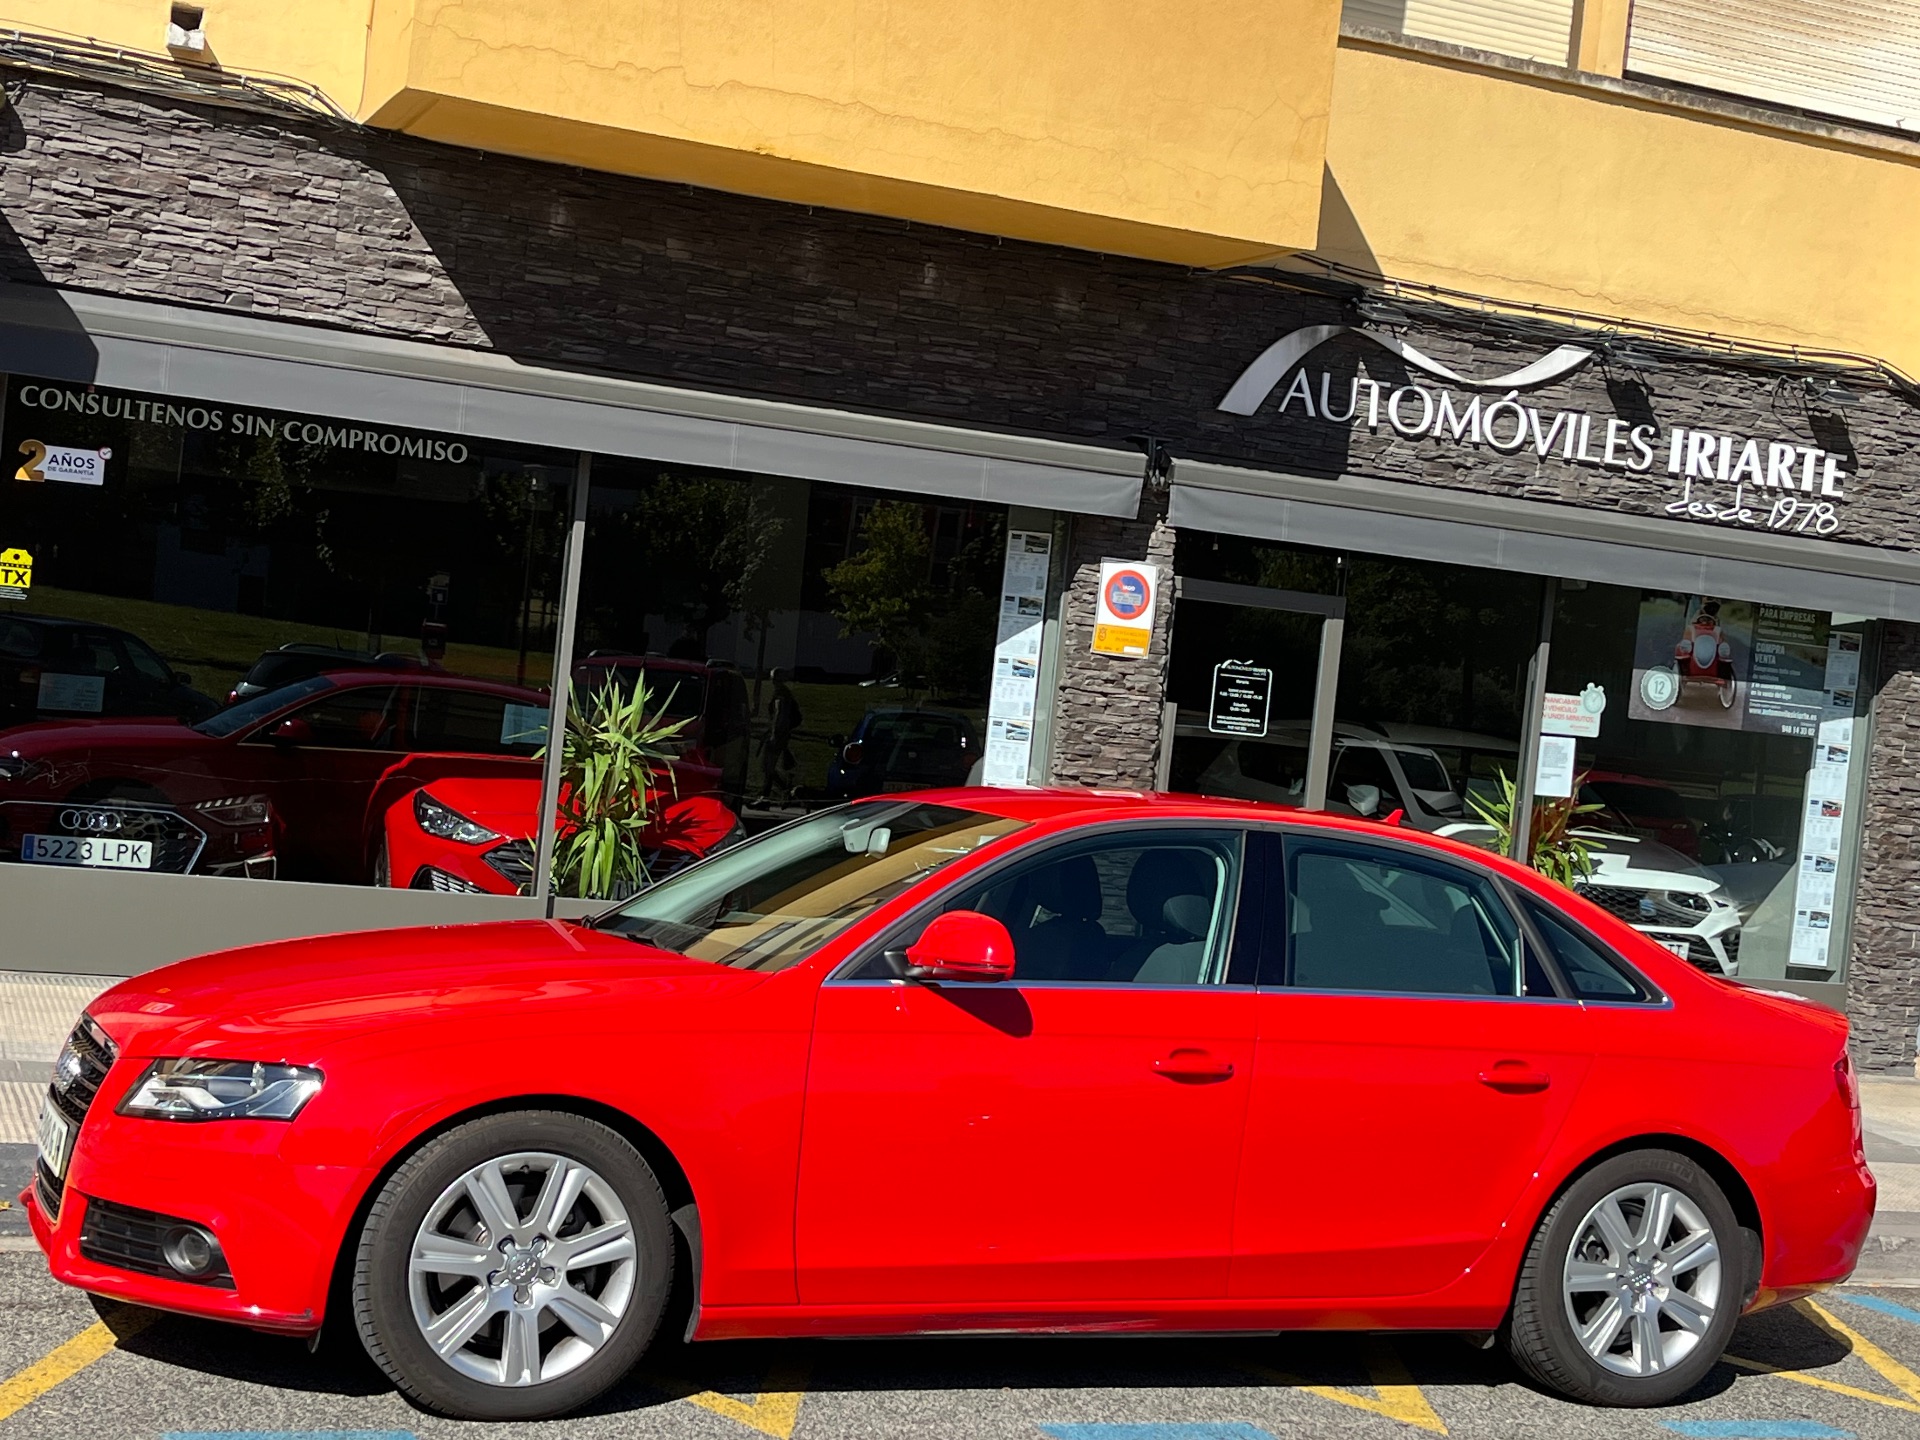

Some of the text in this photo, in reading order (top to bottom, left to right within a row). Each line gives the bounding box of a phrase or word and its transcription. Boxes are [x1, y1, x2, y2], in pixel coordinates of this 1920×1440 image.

[19, 384, 469, 464] CONSULTENOS SIN COMPROMISO
[1278, 367, 1849, 497] AUTOMÓVILES IRIARTE
[15, 439, 95, 482] 2 AÑOS
[1664, 478, 1841, 535] desde 1978
[1754, 653, 1776, 664] VENTA
[1756, 642, 1785, 655] COMPRA
[1654, 680, 1665, 695] 12
[1544, 696, 1582, 706] NANCIAMOS
[37, 838, 144, 863] 5223 LPK
